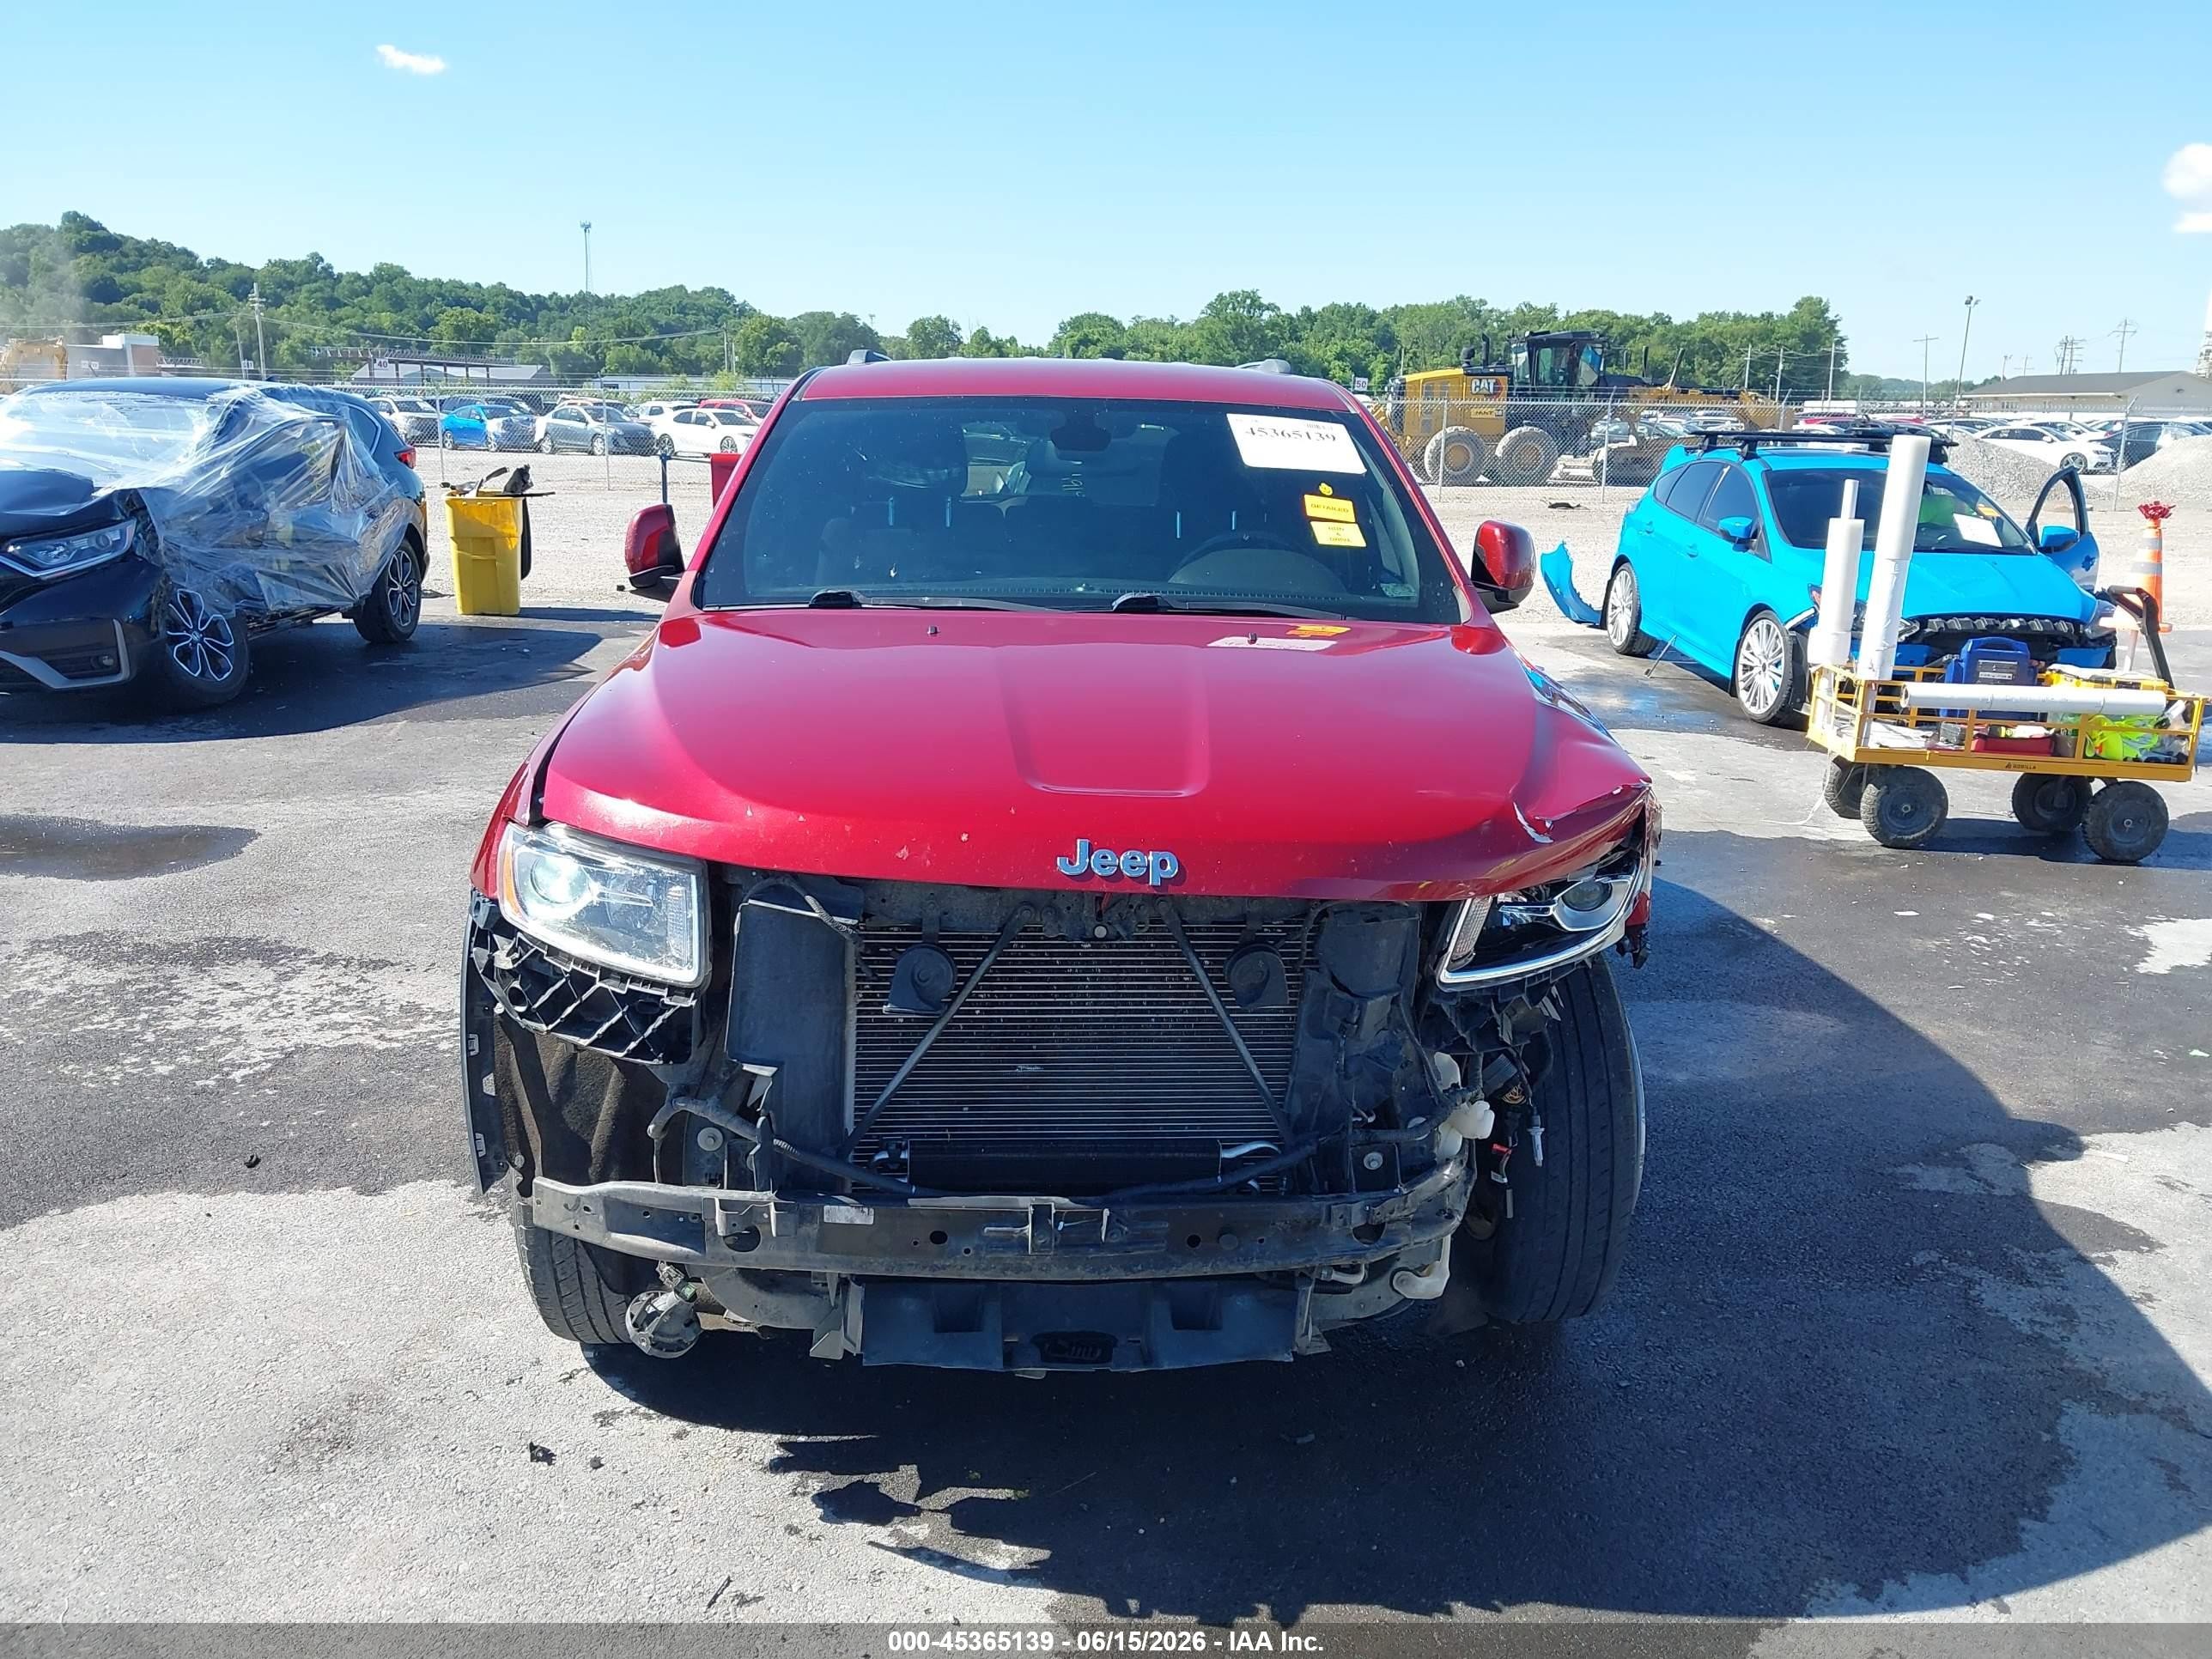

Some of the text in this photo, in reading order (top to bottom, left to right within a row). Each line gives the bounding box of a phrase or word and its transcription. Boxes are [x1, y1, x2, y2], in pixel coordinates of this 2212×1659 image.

[1356, 380, 1366, 388] 50
[1471, 379, 1496, 394] CAT
[1245, 427, 1336, 442] 45365139
[1056, 838, 1179, 886] Jeep
